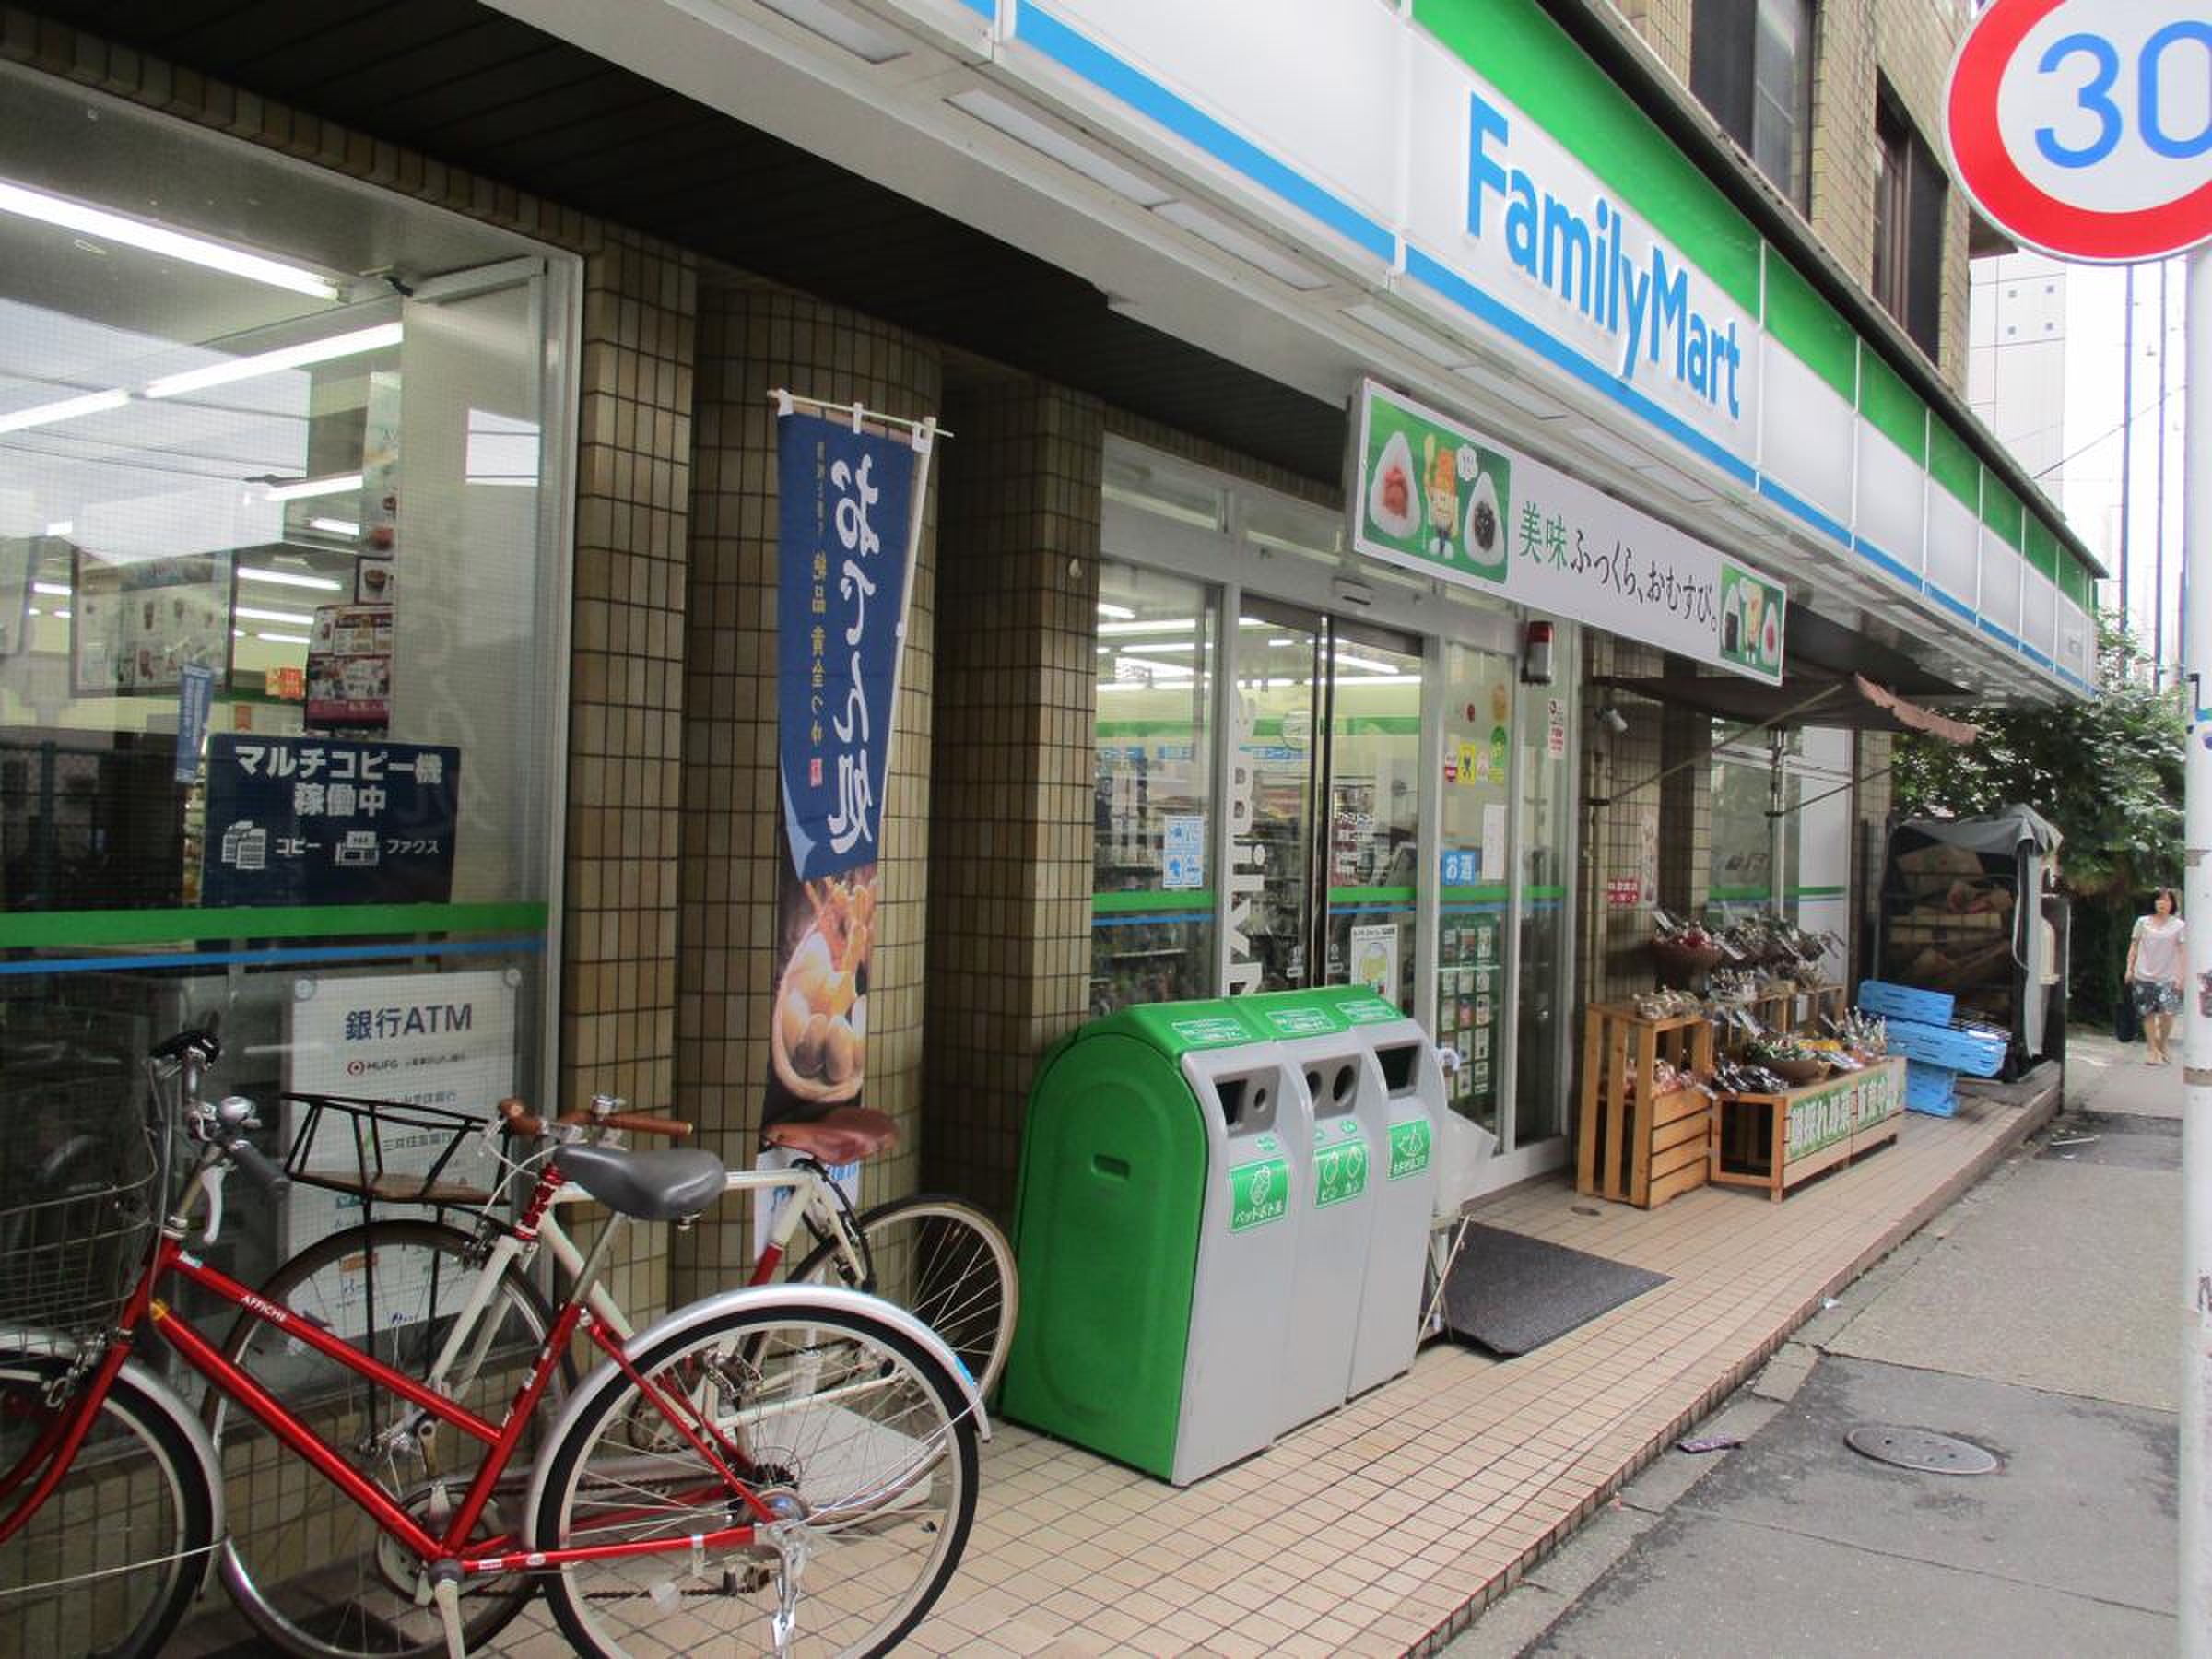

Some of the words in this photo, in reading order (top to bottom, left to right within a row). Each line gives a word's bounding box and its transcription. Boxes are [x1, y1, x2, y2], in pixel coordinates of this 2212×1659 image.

[2034, 20, 2212, 169] 30
[1467, 90, 1740, 420] FamilyMart
[1519, 501, 1716, 632] 美味ふっくら、おむすび。
[235, 746, 443, 784] マルチコピー機
[295, 782, 386, 818] 稼働中
[276, 837, 321, 856] コピー
[386, 839, 441, 854] ファクス
[345, 1003, 472, 1041] 銀行ATM
